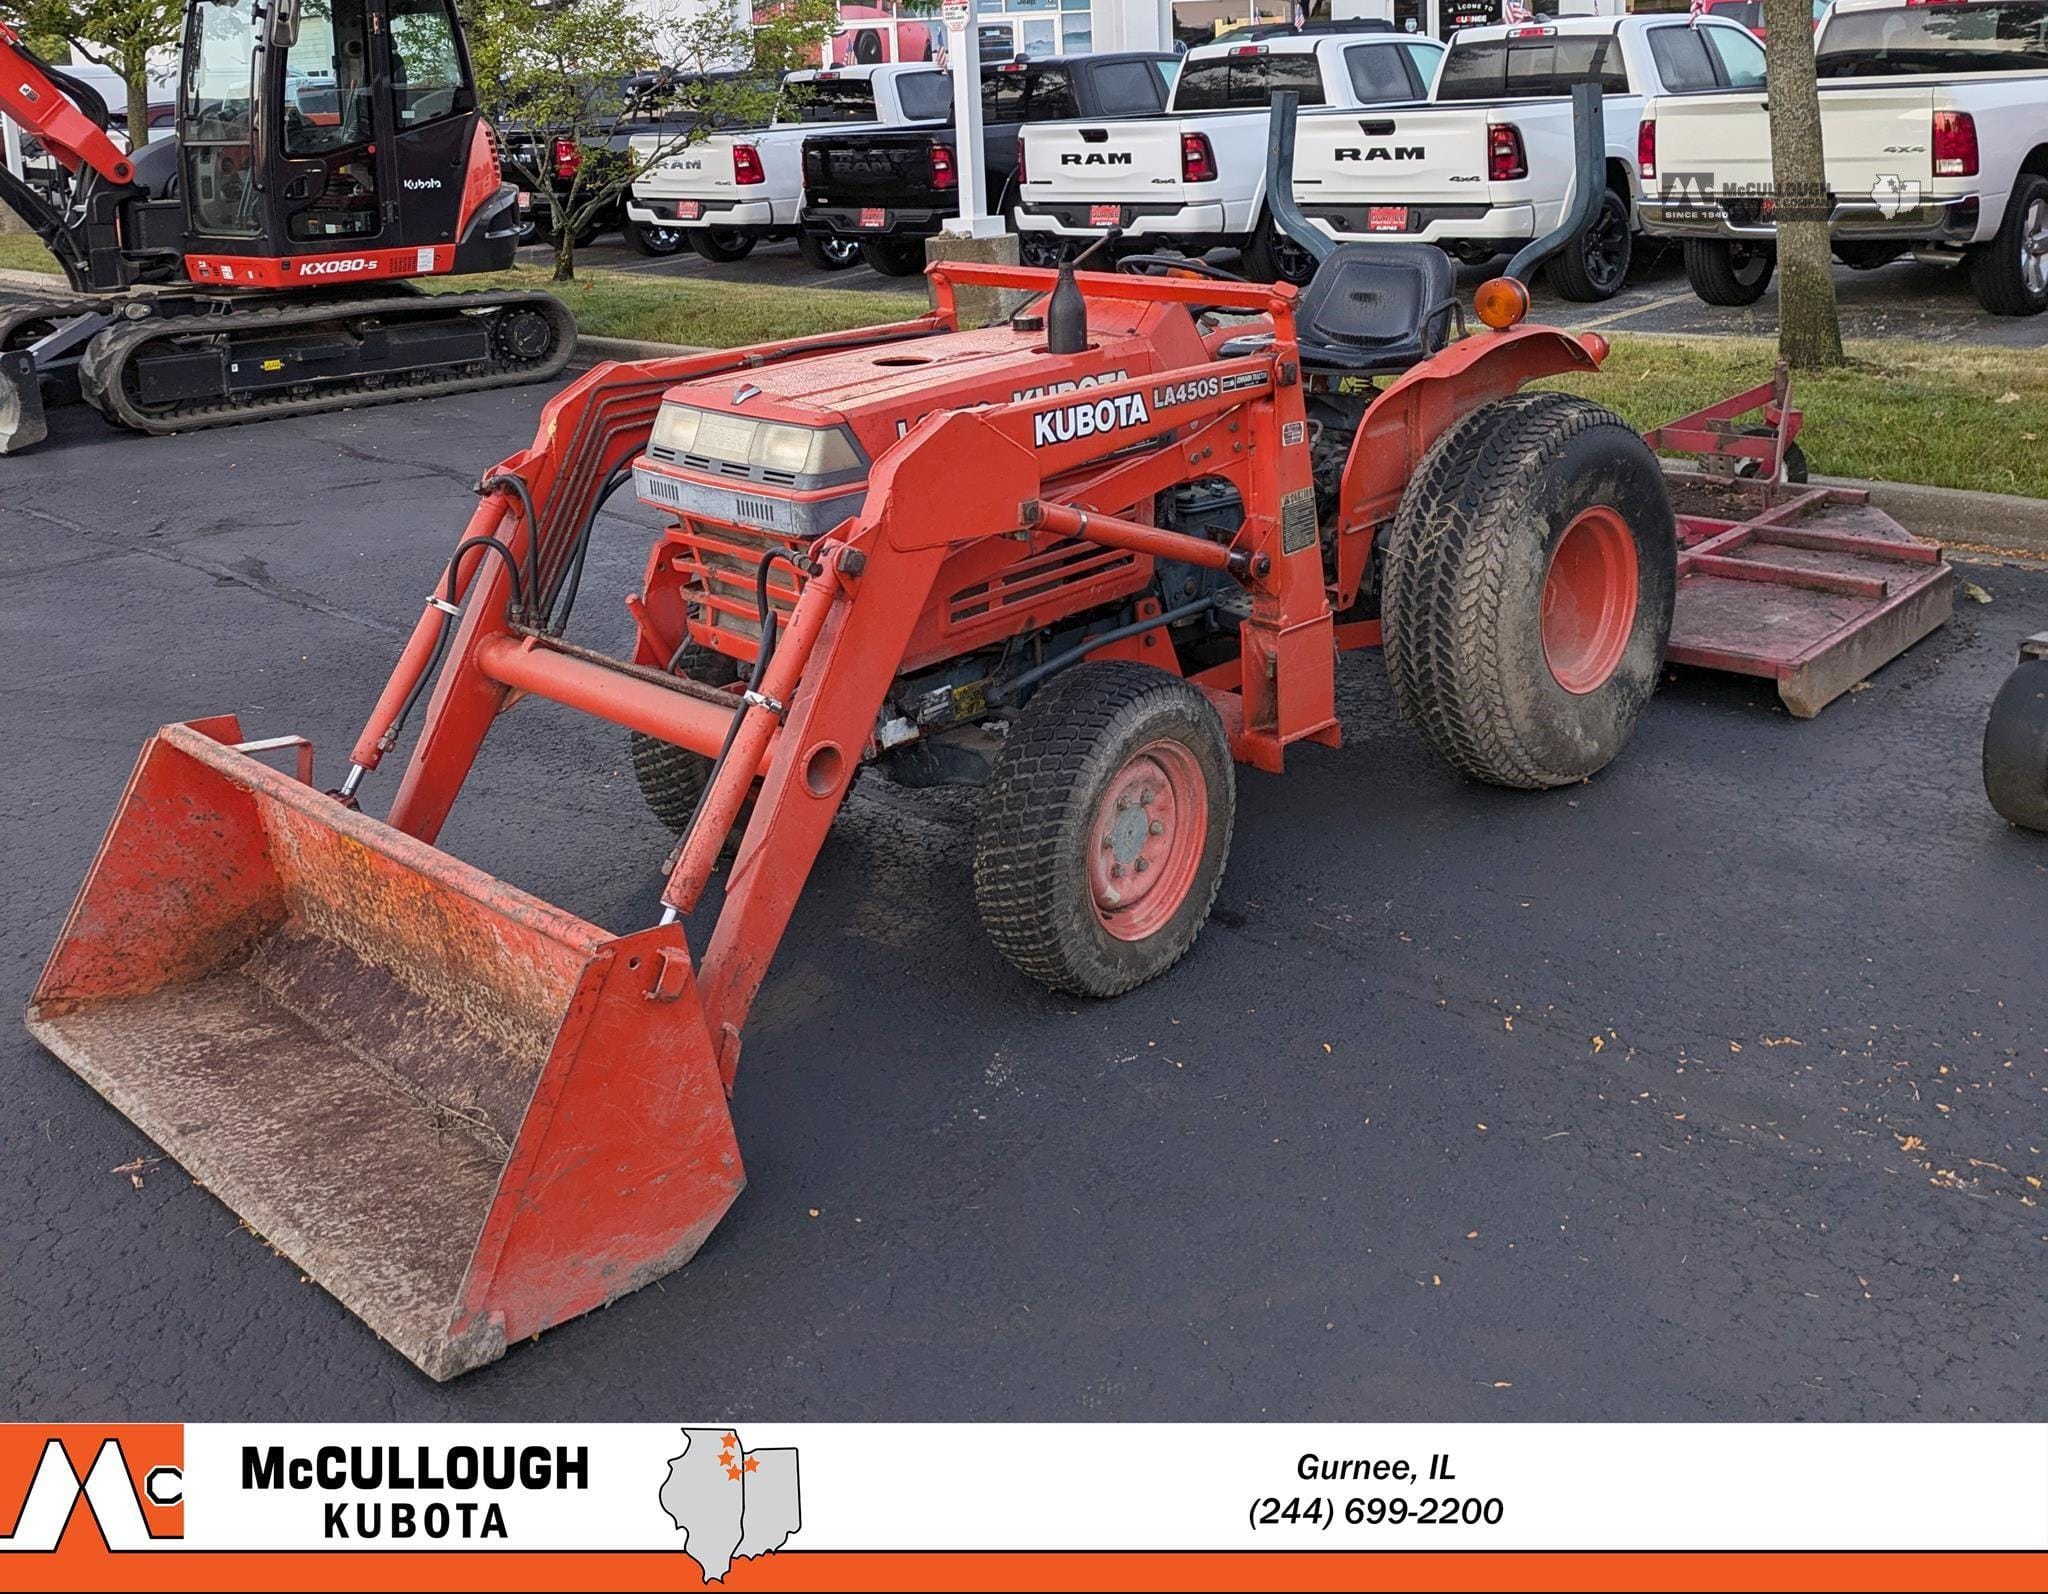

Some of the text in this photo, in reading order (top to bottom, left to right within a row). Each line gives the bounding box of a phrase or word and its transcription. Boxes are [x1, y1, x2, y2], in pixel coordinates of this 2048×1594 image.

[1061, 152, 1132, 165] RAM
[1333, 146, 1425, 161] RAM
[403, 178, 442, 189] Kubota
[1153, 377, 1219, 409] LA450S
[1034, 392, 1150, 447] KUBOTA
